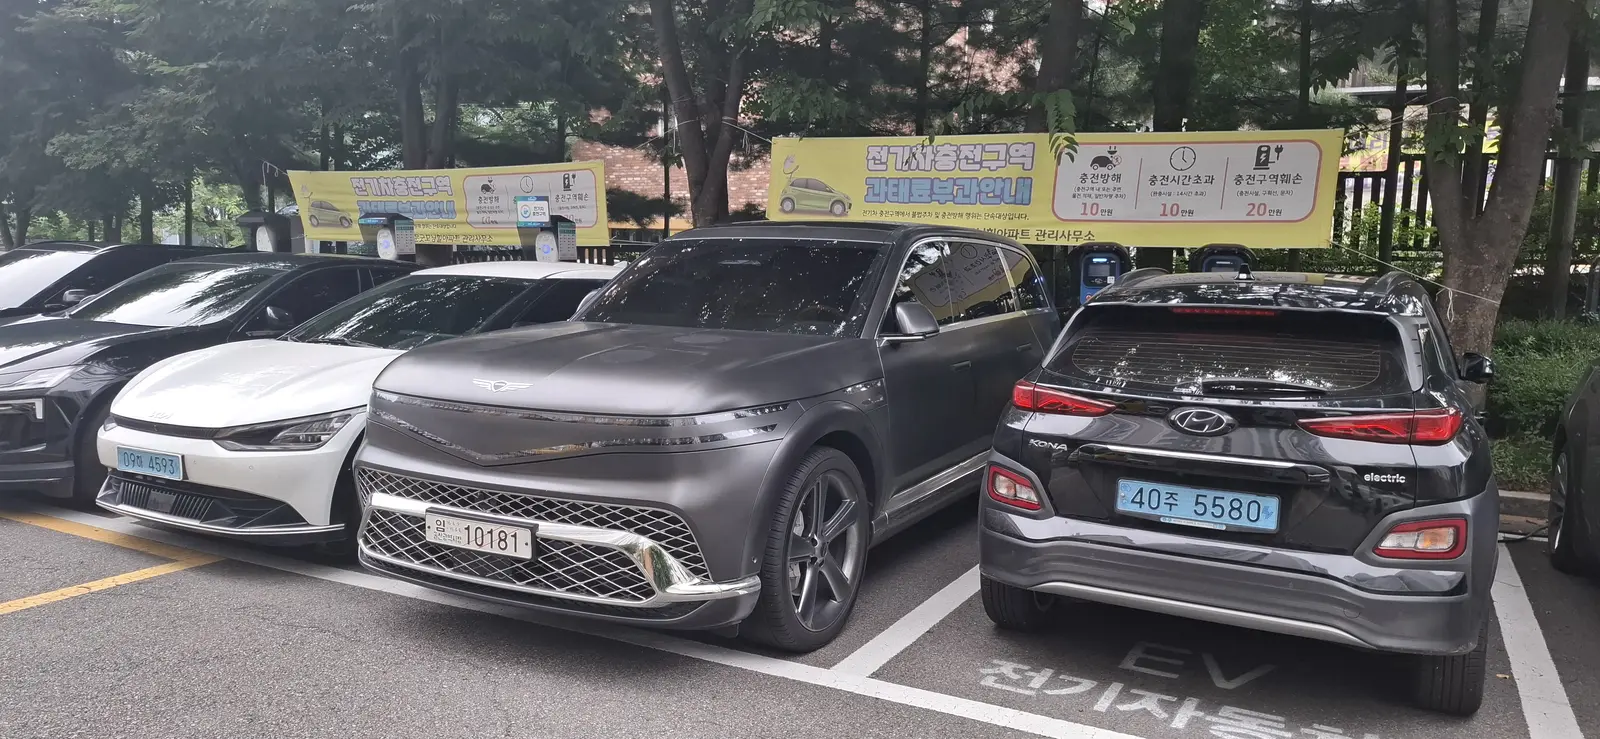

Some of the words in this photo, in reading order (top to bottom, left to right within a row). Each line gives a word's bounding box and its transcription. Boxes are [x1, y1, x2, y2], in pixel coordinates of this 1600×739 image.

[865, 142, 1035, 171] 전기차충전구역
[350, 176, 453, 197] 전기차충전구역
[1079, 172, 1122, 184] 충전방해
[1148, 174, 1215, 186] 충전시간초과
[1233, 173, 1303, 186] 충전구역훼손
[864, 176, 1033, 206] 과태료부과안내
[1034, 228, 1096, 243] 관리사무소
[1028, 438, 1068, 452] KONA
[148, 455, 175, 475] 4593
[1363, 472, 1406, 484] electric
[1130, 486, 1179, 512] 40주
[1193, 494, 1262, 523] 5580
[435, 519, 446, 533] 임
[464, 524, 518, 553] 10181
[1118, 640, 1276, 690] EV
